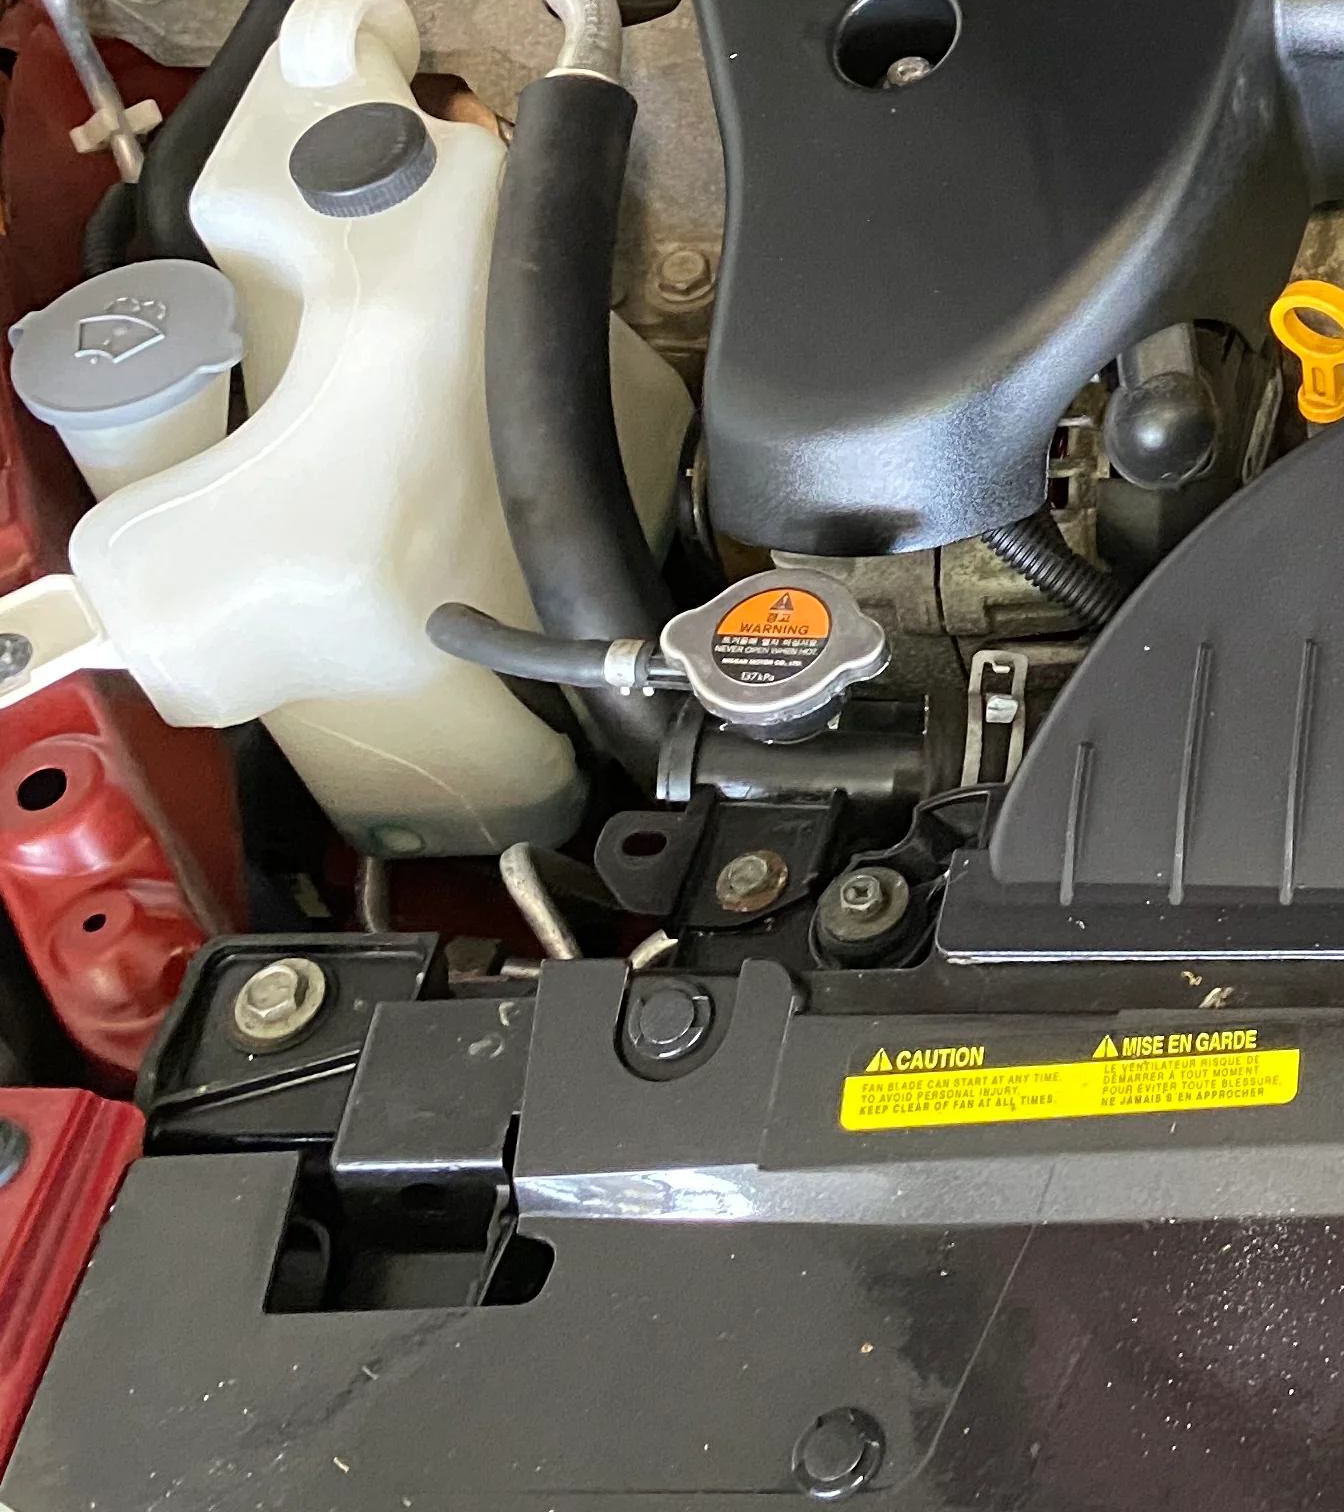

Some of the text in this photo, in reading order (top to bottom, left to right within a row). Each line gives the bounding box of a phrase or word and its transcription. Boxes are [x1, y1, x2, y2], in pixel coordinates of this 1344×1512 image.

[740, 622, 810, 635] WARNING
[714, 645, 744, 653] NEVER
[744, 646, 770, 654] OPEN
[770, 647, 798, 655] WHEN
[1122, 1030, 1258, 1057] MISE EN GARDE
[896, 1046, 985, 1070] CAUTION
[1104, 1055, 1260, 1074] LE VENTILATEUR RISQUE DE
[862, 1083, 883, 1093] FAN
[888, 1080, 923, 1092] BLADE
[927, 1079, 950, 1089] CAN
[953, 1076, 988, 1087] START
[991, 1074, 1004, 1084] AT
[1008, 1073, 1030, 1083] ANY
[1180, 1069, 1208, 1079] TOUT
[861, 1094, 876, 1104] TO
[880, 1091, 912, 1103] AVOID
[917, 1088, 976, 1101] PERSONAL
[1102, 1085, 1132, 1095] POUR
[1181, 1079, 1216, 1090] TOUTE
[1101, 1097, 1116, 1106] NE
[1120, 1093, 1162, 1106] JAMAIS
[1196, 1088, 1264, 1100] APPROCHER
[859, 1105, 889, 1116] KEEP
[892, 1103, 930, 1114] CLEAR
[934, 1101, 949, 1111] OF
[953, 1099, 975, 1110] FAN
[978, 1098, 992, 1108] AT
[995, 1097, 1015, 1108] ALL
